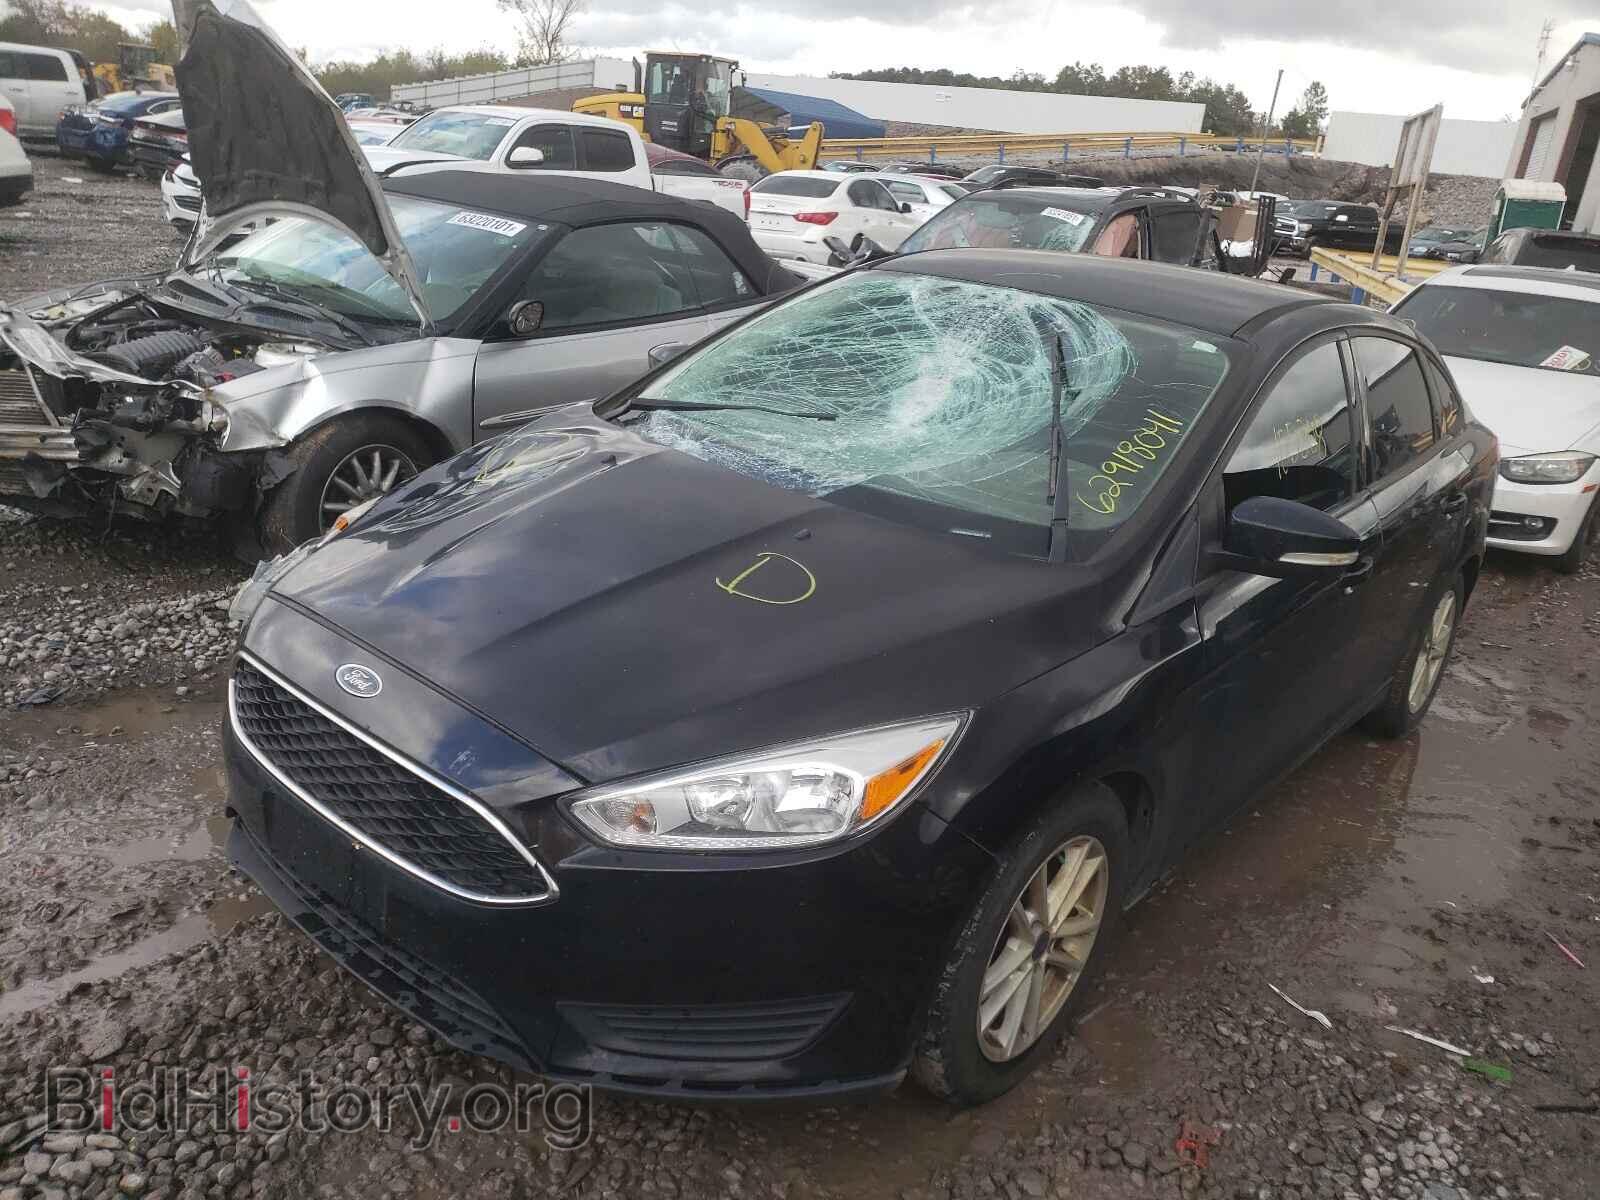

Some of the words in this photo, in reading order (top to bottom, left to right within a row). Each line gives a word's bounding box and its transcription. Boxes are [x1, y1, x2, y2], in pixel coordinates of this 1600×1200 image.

[1076, 408, 1183, 513] 62918041
[715, 552, 816, 604] D
[343, 668, 376, 693] Ford
